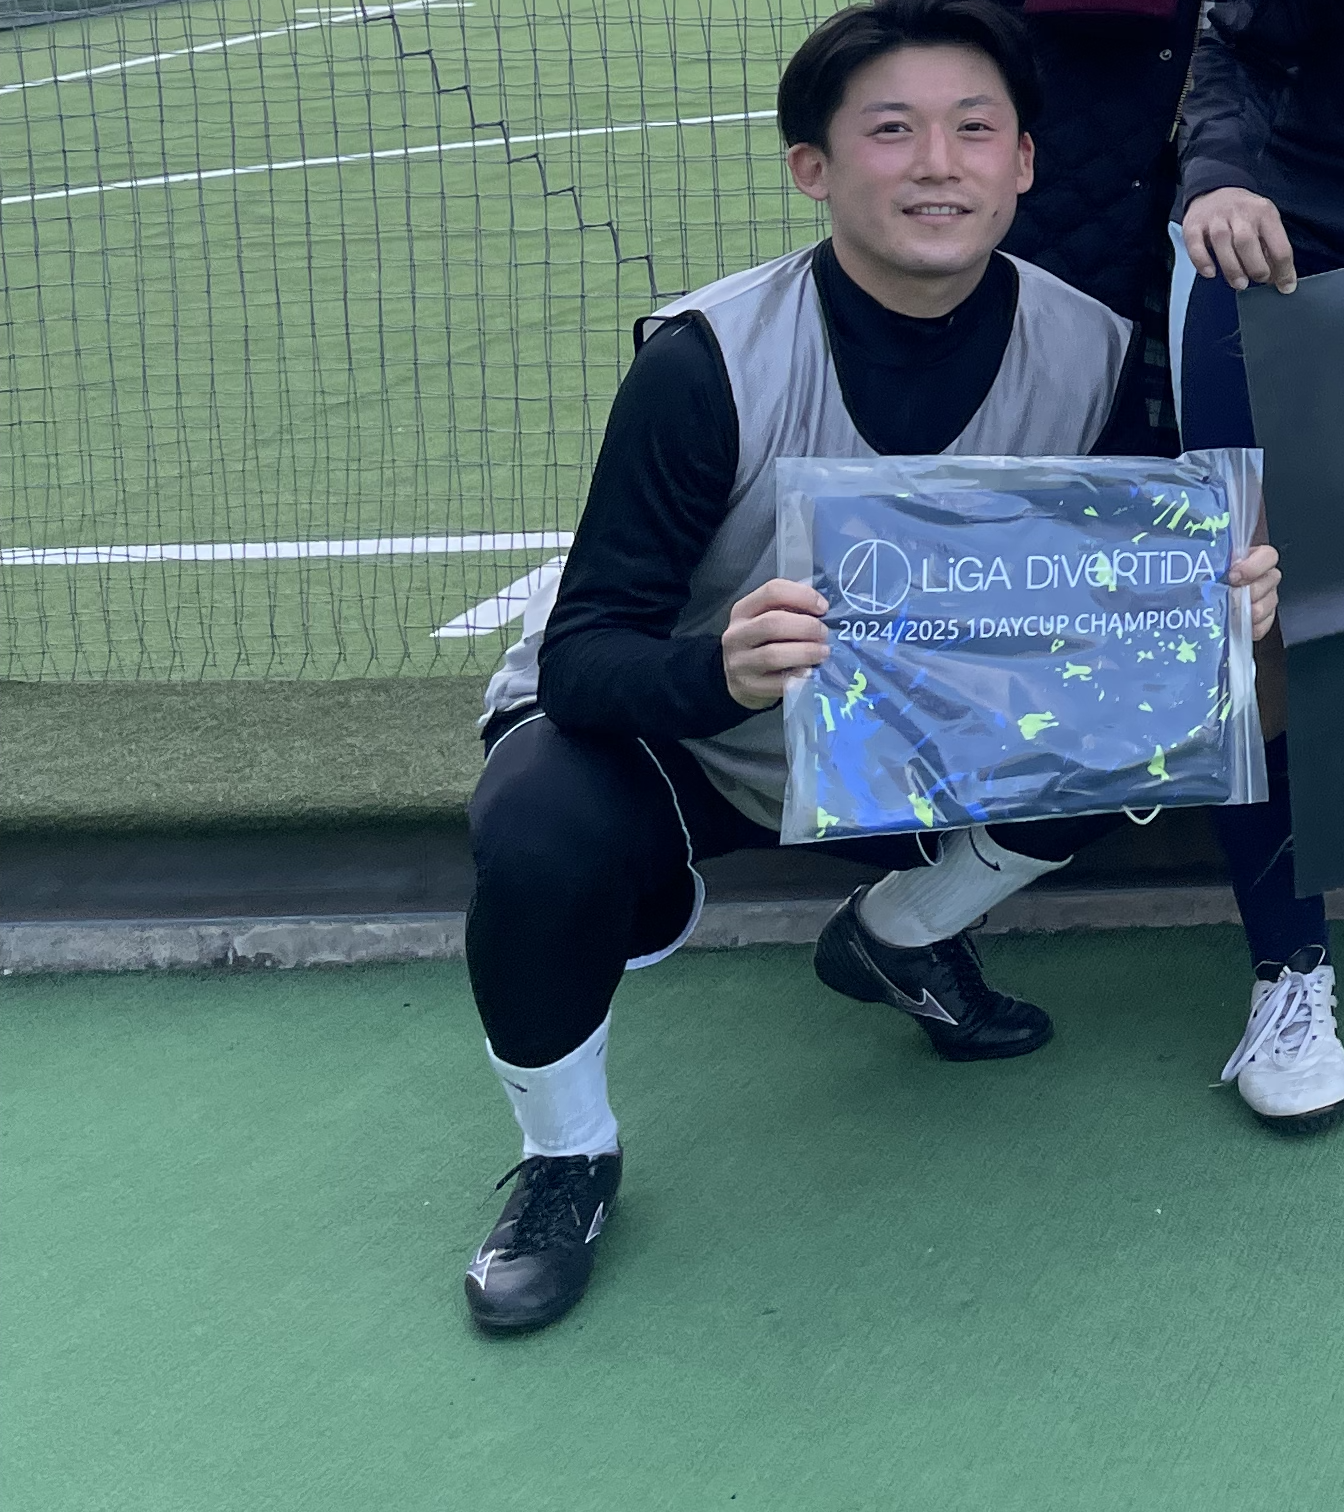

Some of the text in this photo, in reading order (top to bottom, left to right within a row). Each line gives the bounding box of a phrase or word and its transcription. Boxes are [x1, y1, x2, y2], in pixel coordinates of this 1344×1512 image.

[837, 607, 1216, 643] 2024/2025 1DAYCUP CHAMPIONS
